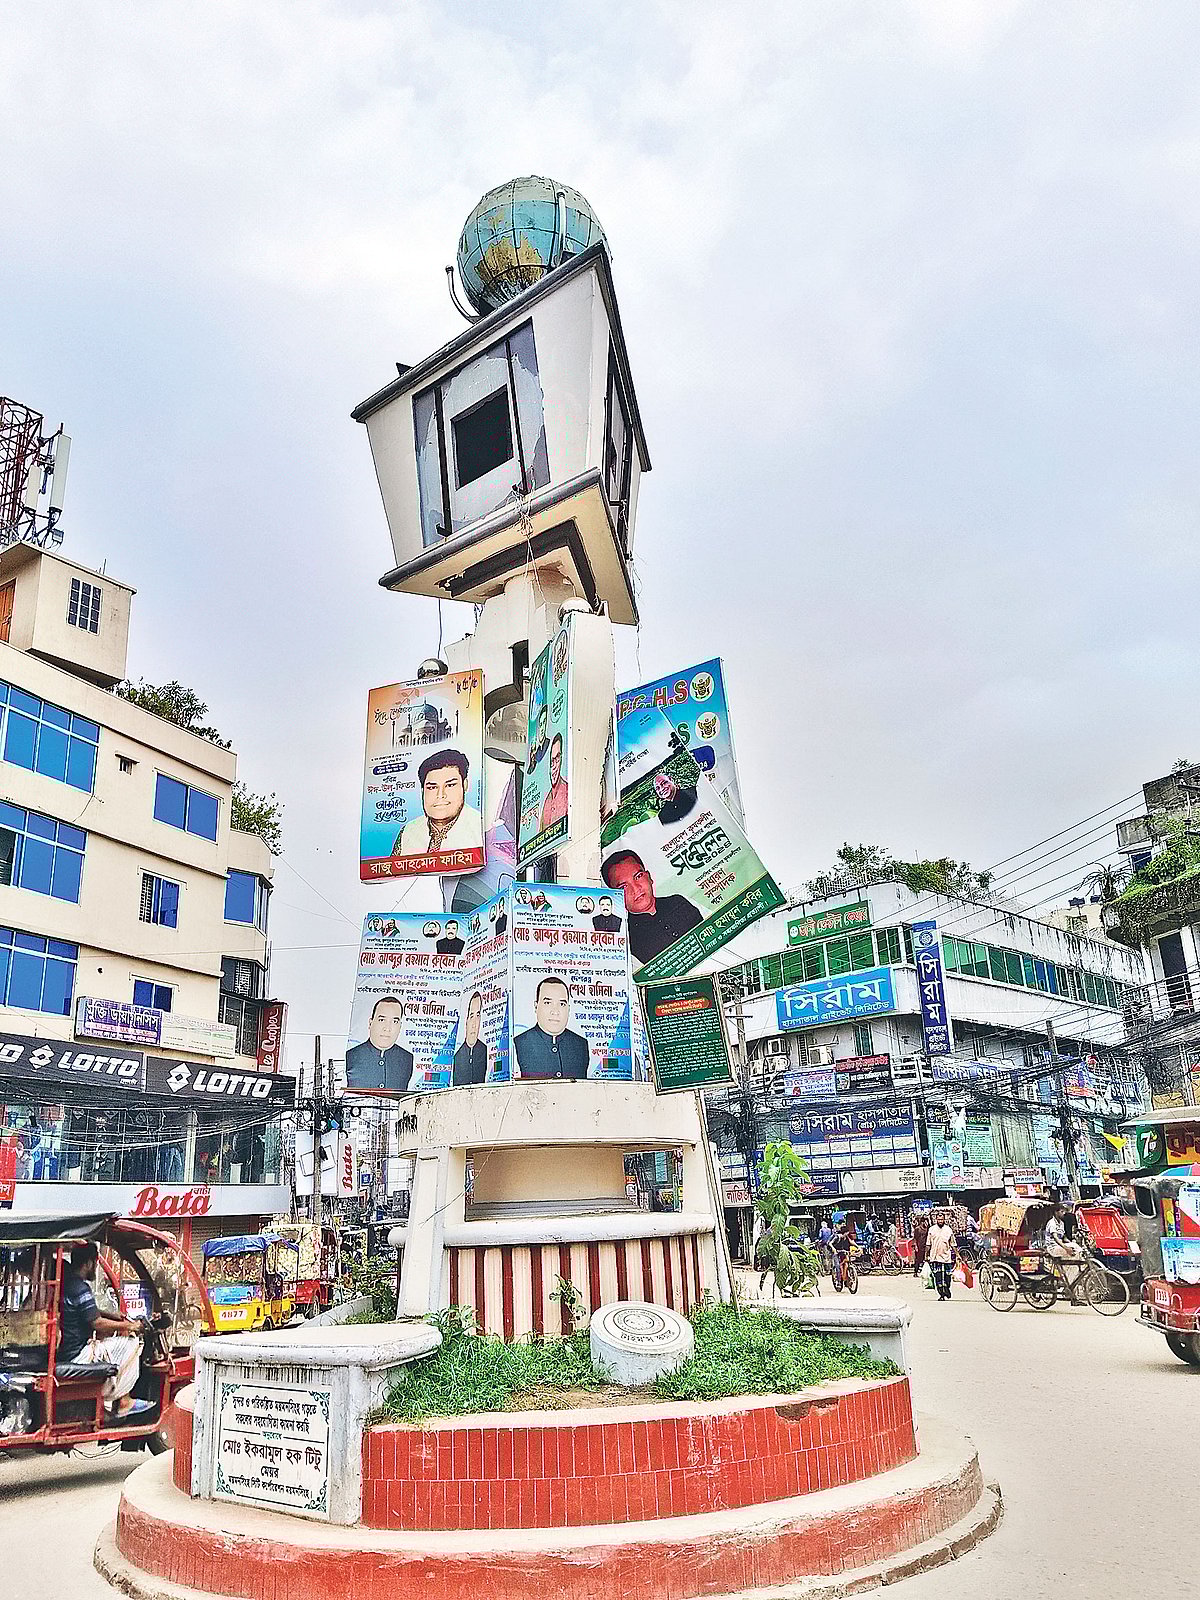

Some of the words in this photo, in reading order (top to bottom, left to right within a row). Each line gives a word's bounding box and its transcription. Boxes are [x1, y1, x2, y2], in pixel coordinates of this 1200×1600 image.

[661, 829, 688, 853] বাংলাদেশ
[686, 810, 713, 836] কৃষকলীগ
[370, 863, 392, 875] রাজু
[395, 857, 437, 872] আহমেদ
[440, 850, 473, 866] ফাহিম
[670, 826, 729, 876] সম্মেলন
[698, 868, 727, 891] সাধারণ
[704, 872, 736, 900] সম্পাদক
[709, 895, 724, 906] পদে
[699, 924, 716, 943] মোঃ
[739, 888, 763, 909] কবির
[513, 927, 530, 943] মোঃ
[533, 928, 560, 947] আব্দুর
[562, 930, 588, 945] রহমান
[590, 932, 615, 948] রুবেল
[360, 952, 376, 967] মোঃ
[379, 952, 402, 969] আব্দুর
[405, 953, 430, 967] রহমান
[432, 954, 456, 969] রুবেল
[569, 984, 585, 998] শেখ
[588, 981, 613, 997] হাসিনা
[779, 980, 887, 1018] সিরাম
[918, 952, 942, 1023] সিরাম
[403, 1002, 420, 1017] শেখ
[421, 1001, 445, 1016] হাসিনা
[781, 1015, 820, 1028] হাসপাতাল
[820, 1008, 853, 1021] প্রাইভেট
[854, 1001, 890, 1013] লিমিটেড
[261, 1008, 281, 1049] Cooper
[57, 1051, 140, 1077] LOTTO
[258, 1054, 275, 1073] Lee
[192, 1070, 273, 1098] LOTTO
[804, 1110, 854, 1133] সিরাম
[856, 1106, 910, 1120] হাসপাতাল
[878, 1118, 909, 1128] লিমিটেড
[342, 1143, 353, 1191] Bata
[129, 1185, 213, 1216] Bata
[192, 1187, 211, 1195] বাটা
[223, 1438, 242, 1455] মোঃ
[244, 1437, 284, 1465] ইকরামুল
[286, 1448, 302, 1465] হক
[305, 1446, 322, 1472] টিটু
[260, 1465, 279, 1478] মেয়র
